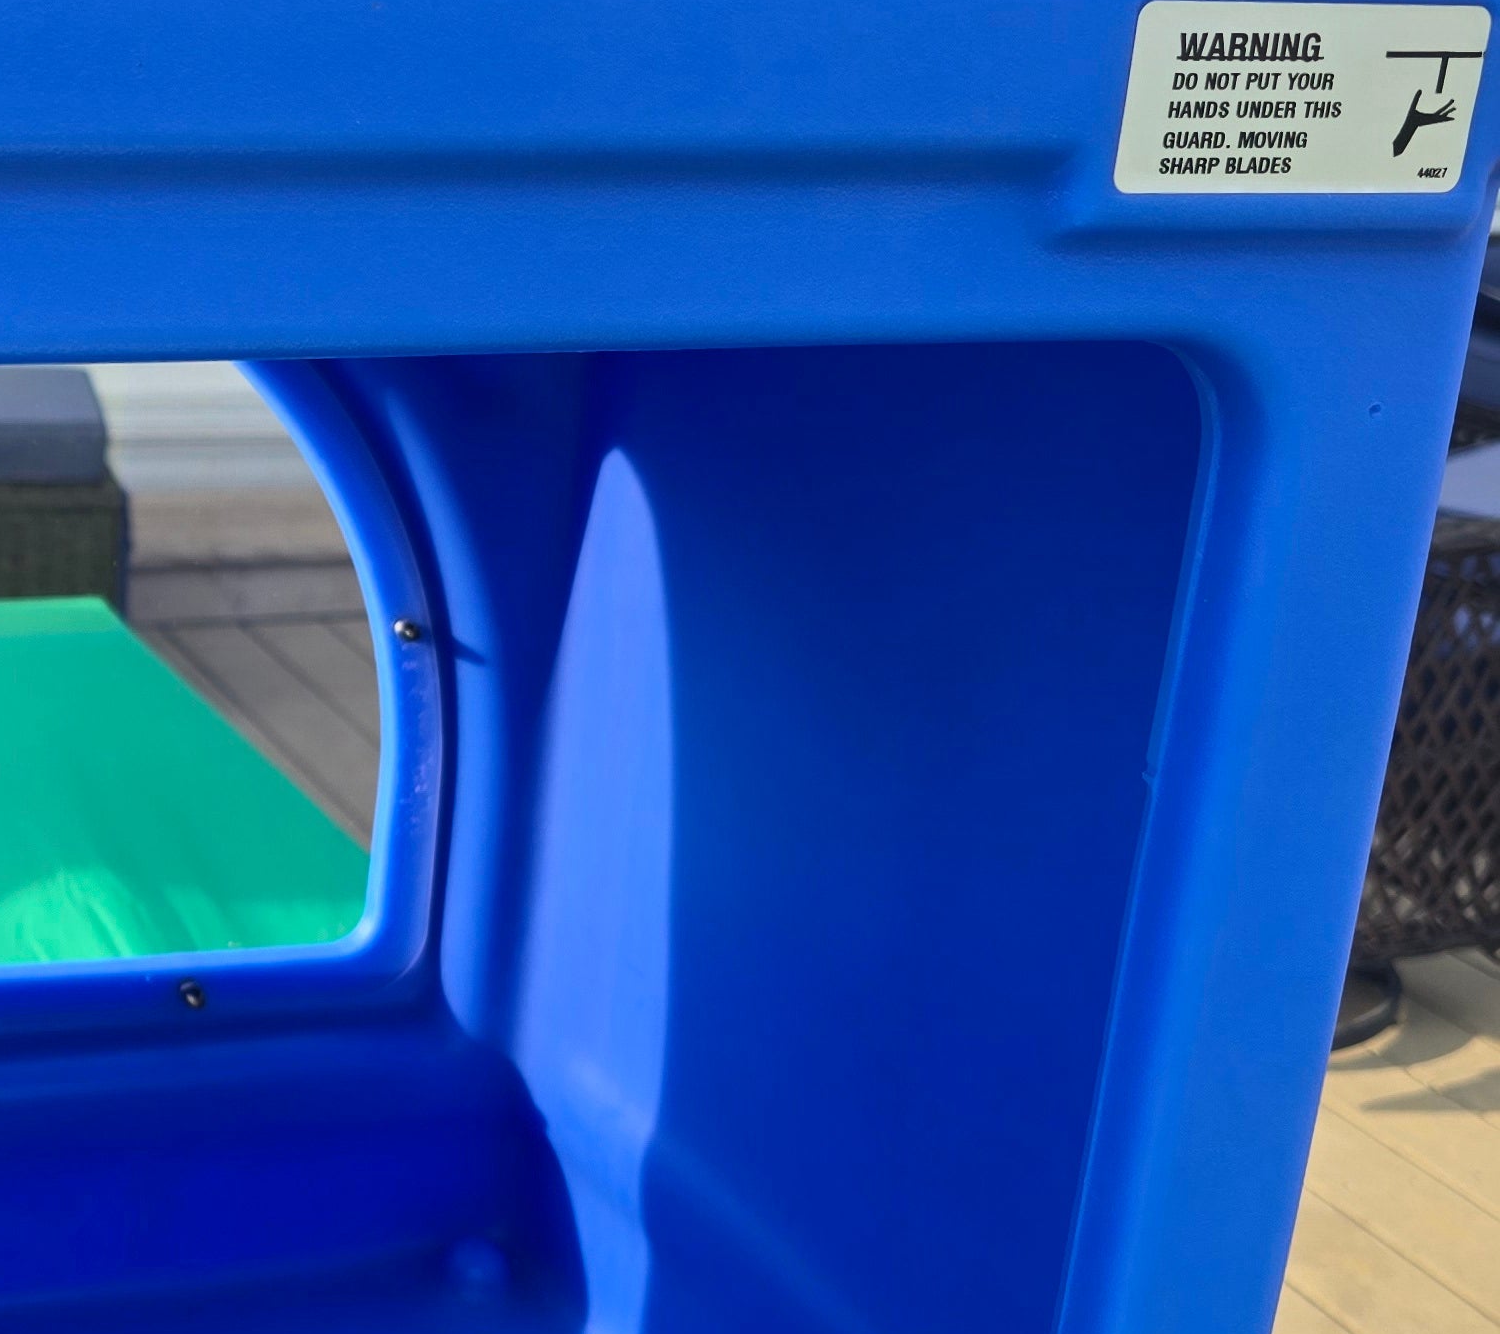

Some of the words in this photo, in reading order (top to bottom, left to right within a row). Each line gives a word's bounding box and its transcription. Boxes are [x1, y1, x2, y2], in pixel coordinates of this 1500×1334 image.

[1177, 32, 1324, 62] WARNING
[1172, 72, 1198, 91] DO
[1204, 72, 1238, 91] NOT
[1245, 72, 1282, 91] PUT
[1287, 72, 1335, 91] YOUR
[1167, 101, 1230, 119] HANDS
[1235, 101, 1296, 119] UNDER
[1303, 101, 1343, 119] THIS
[1162, 131, 1231, 149] GUARD.
[1237, 131, 1308, 149] MOVING
[1158, 157, 1220, 175] SHARP
[1224, 157, 1292, 175] BLADES
